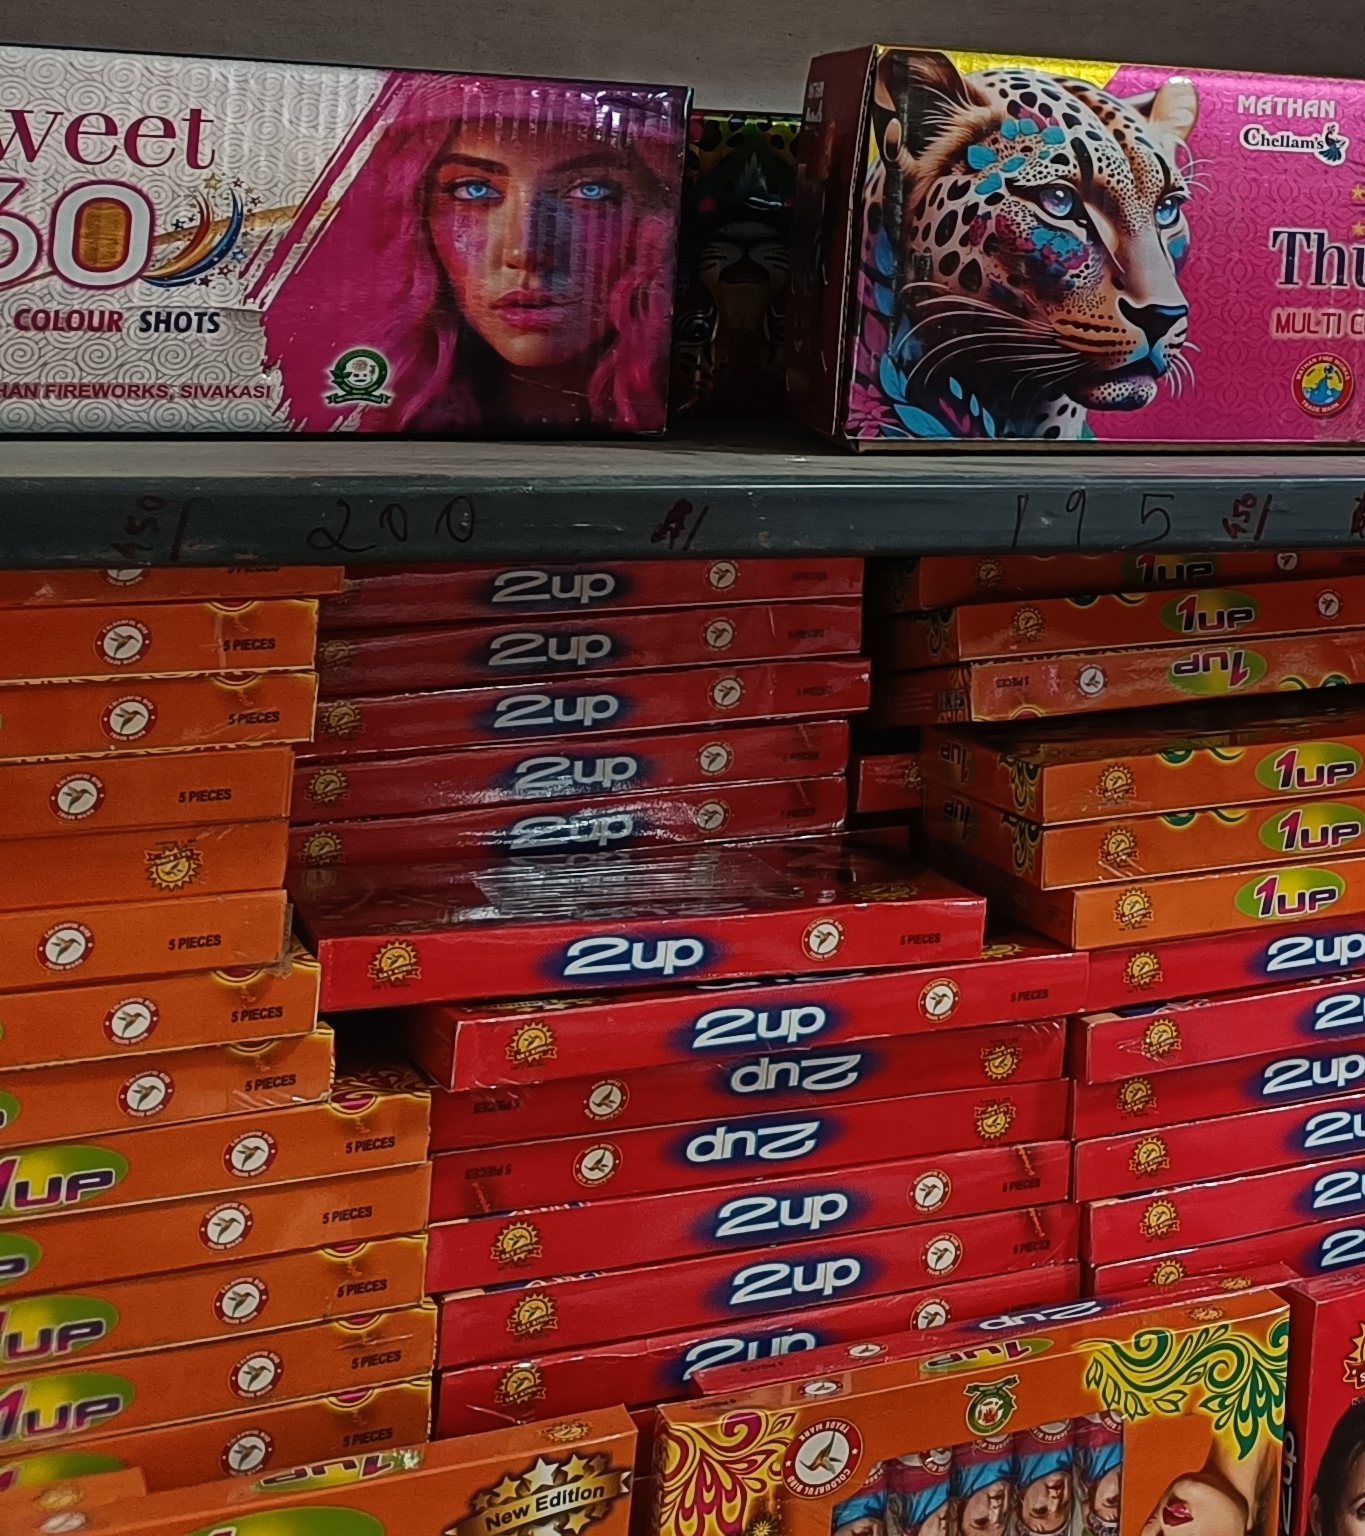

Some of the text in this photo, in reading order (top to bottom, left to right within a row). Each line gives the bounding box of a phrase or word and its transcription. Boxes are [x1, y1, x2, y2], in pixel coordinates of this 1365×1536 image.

[1237, 94, 1337, 119] MATHAN
[1243, 124, 1325, 152] Chellam's
[13, 310, 221, 333] COLOUR SHOTS
[1274, 312, 1344, 337] MULTI
[44, 383, 270, 400] FIREWORKS, SIVAKASI
[179, 789, 231, 803] 5 PIECES
[563, 937, 704, 979] 2up
[691, 1006, 826, 1050] 2up
[686, 1121, 821, 1163] 2up
[486, 1481, 605, 1531] New Edition
